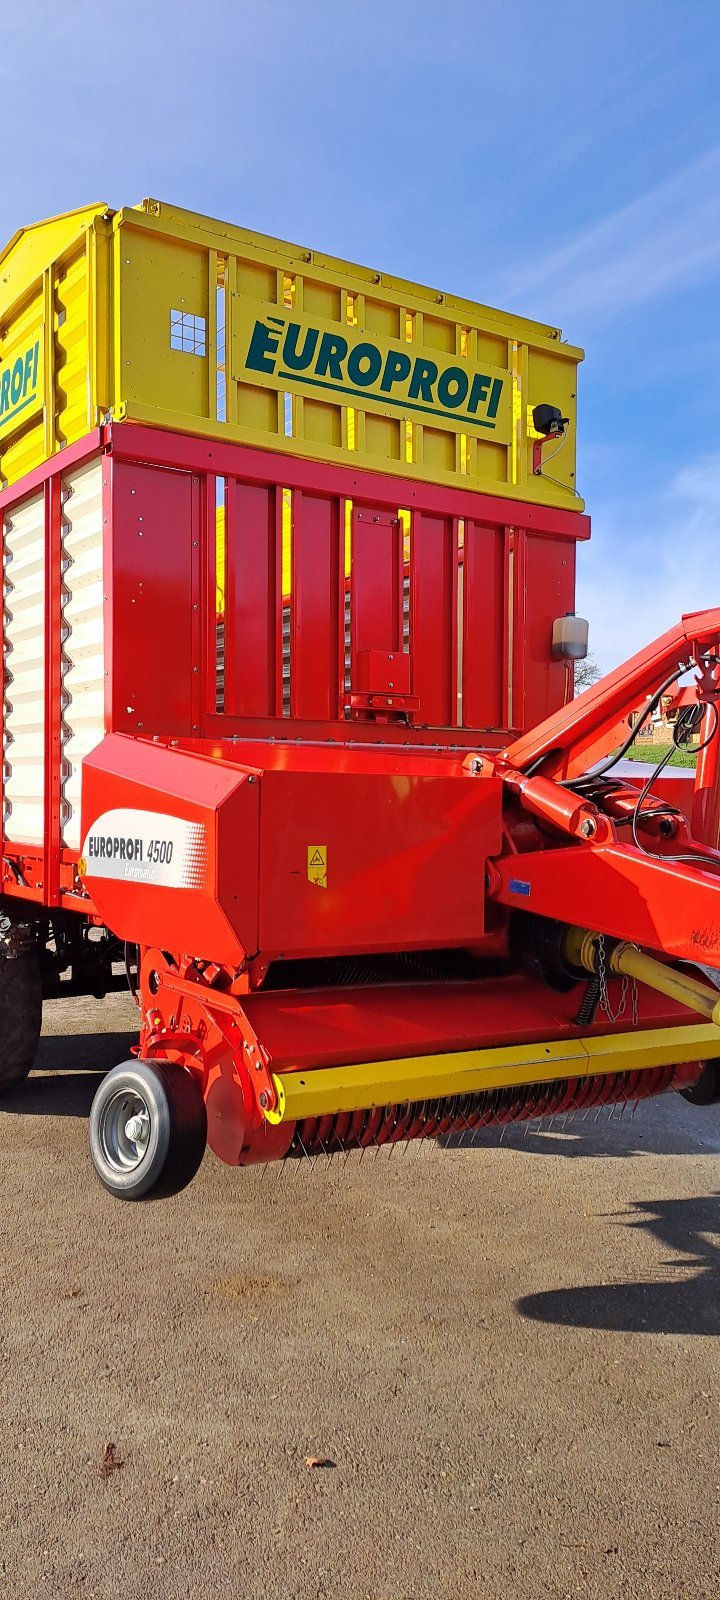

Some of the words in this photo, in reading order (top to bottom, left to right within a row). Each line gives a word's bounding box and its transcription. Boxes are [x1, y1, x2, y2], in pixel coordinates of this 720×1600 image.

[245, 316, 503, 418] EUROPROFI
[88, 836, 143, 861] EUROPROFI
[147, 840, 173, 864] 4500
